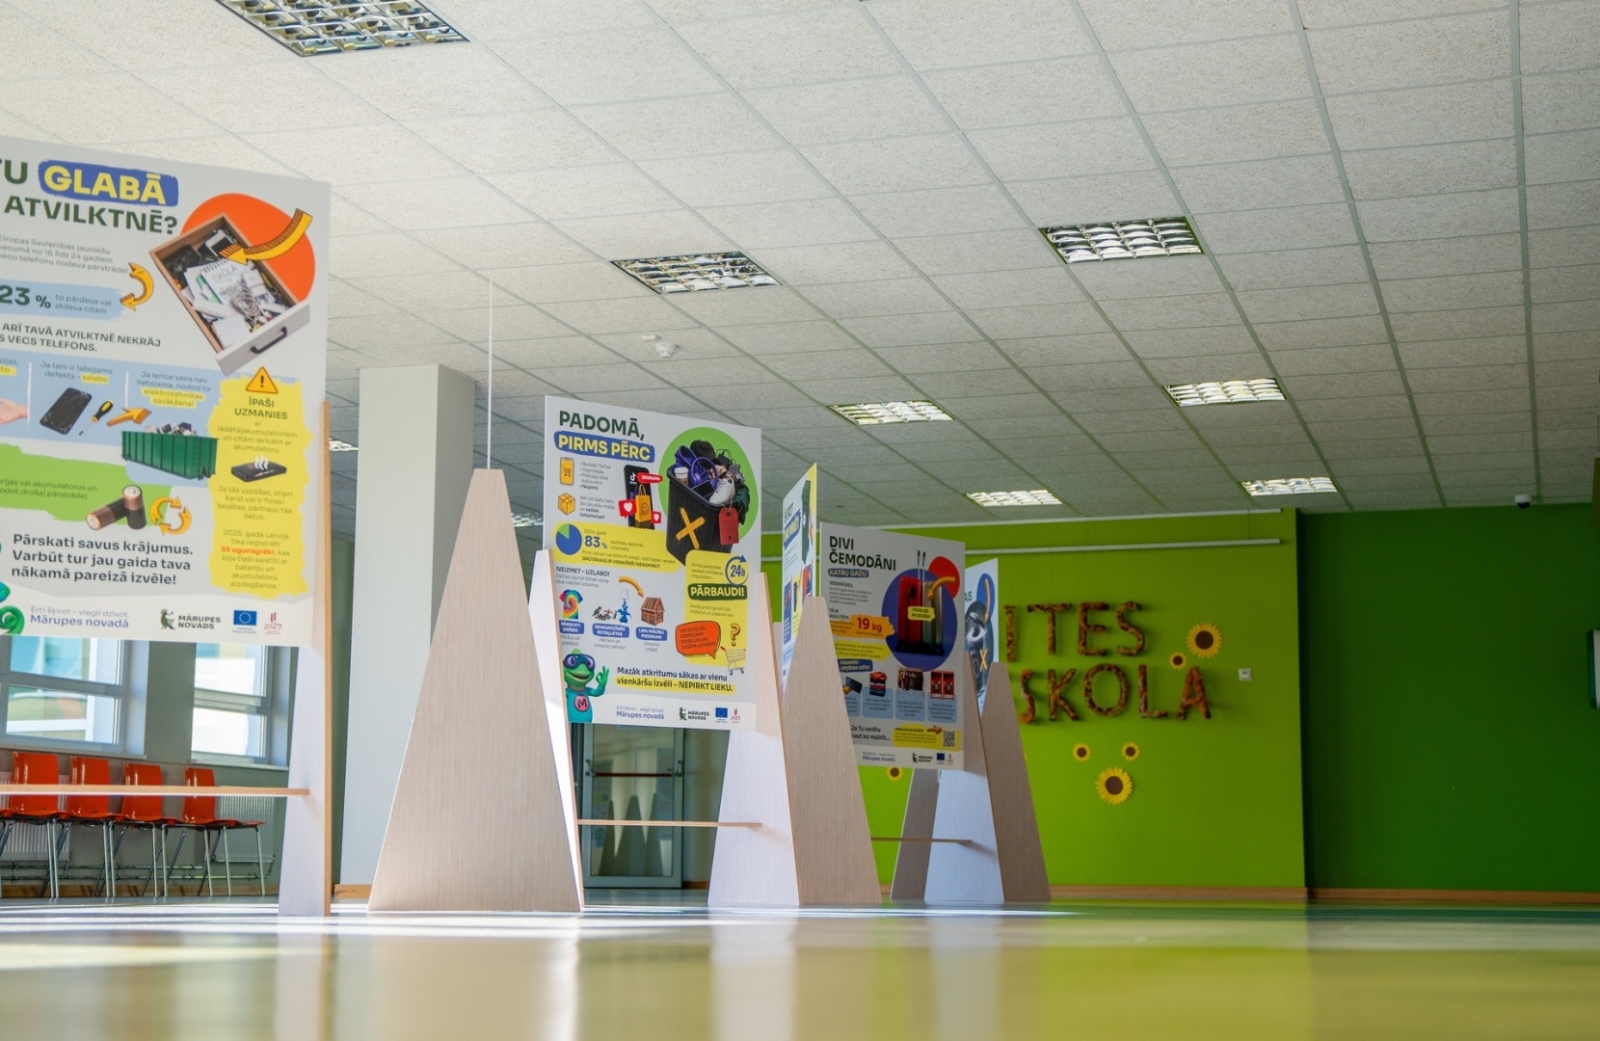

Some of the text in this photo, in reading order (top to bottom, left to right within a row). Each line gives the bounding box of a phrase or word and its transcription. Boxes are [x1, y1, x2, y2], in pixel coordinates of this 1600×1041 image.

[0, 159, 166, 205] U GLABĀ
[4, 195, 178, 235] ATVILKTNĒ?
[31, 238, 75, 251] Savienības
[77, 244, 111, 256] jauniešu
[20, 255, 54, 266] telefonu
[56, 259, 86, 269] nodeva
[45, 247, 53, 257] 16
[55, 248, 69, 259] līdz
[71, 252, 81, 260] 24
[82, 253, 113, 266] gadiem
[0, 285, 51, 309] 23 %
[55, 294, 112, 307] to pārdeva vai
[55, 302, 82, 313] atdeva
[2, 323, 161, 347] ARĪ TAVĀ ATVILKTNĒ NEKRĀJ
[8, 335, 37, 347] VECS
[40, 338, 98, 352] TELEFONS.
[40, 361, 50, 369] Ja
[52, 363, 68, 371] tam
[77, 364, 113, 376] labojams
[44, 370, 75, 380] defekts
[82, 374, 109, 384] salabo
[141, 371, 150, 379] Ja
[175, 374, 194, 383] vairs
[176, 382, 200, 392] nodod
[234, 408, 288, 420] UZMANIES
[559, 410, 645, 442] PADOMĀ,
[558, 434, 651, 462] PIRMS PĒRC
[19, 480, 31, 488] vai
[32, 480, 86, 492] akumulatorus
[13, 533, 193, 556] Pārskati savus krājumus.
[584, 535, 601, 548] 83
[829, 535, 854, 550] DIVI
[12, 549, 191, 571] Varbūt tur jau gaida tava
[829, 549, 896, 571] ČEMODĀNI
[11, 565, 177, 585] nākamā pareizā izvēle!
[730, 564, 745, 578] 24h
[690, 585, 745, 597] PĀRBAUDI!
[78, 608, 100, 618] viegli
[178, 613, 221, 623] MĀRUPES
[30, 614, 129, 629] Mārupes novadā
[178, 621, 215, 630] NOVADS
[857, 617, 870, 630] 19
[872, 623, 882, 633] kg
[617, 666, 640, 675] Mazāk
[642, 669, 677, 679] atkritumu
[678, 671, 699, 680] sākas
[708, 673, 728, 681] vienu
[617, 677, 652, 687] vienkāršu
[653, 678, 672, 688] izvēli
[679, 681, 710, 690] NEPIRKT
[711, 683, 733, 691] LIEKU.
[1020, 663, 1211, 724] SKOLA
